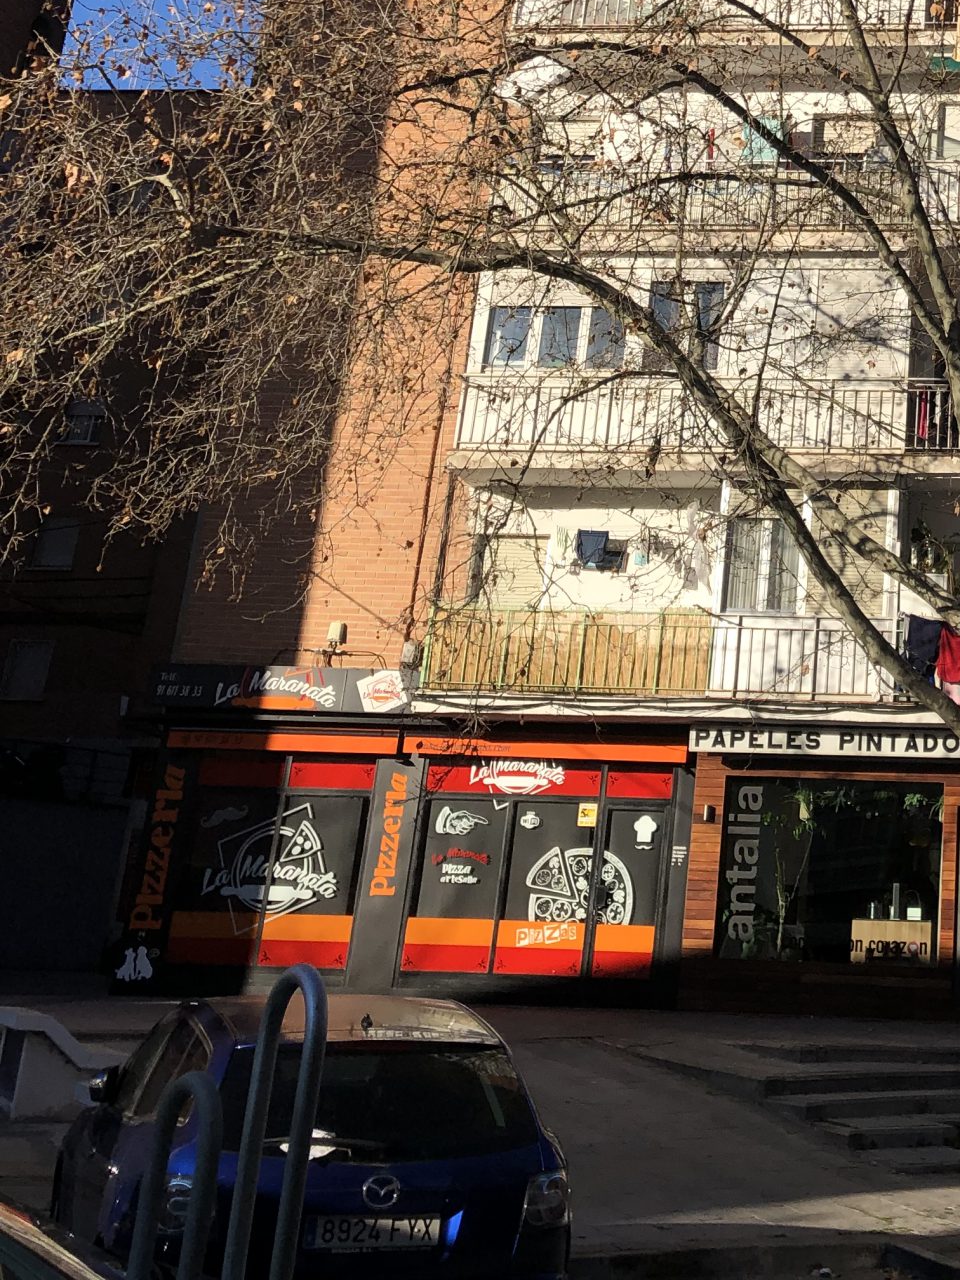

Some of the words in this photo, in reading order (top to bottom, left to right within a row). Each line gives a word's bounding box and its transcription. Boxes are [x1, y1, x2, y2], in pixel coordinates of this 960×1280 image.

[214, 681, 241, 706] La
[249, 671, 336, 709] Maranata
[694, 728, 821, 751] PAPELES
[469, 761, 490, 785] La
[496, 759, 566, 785] Maranata
[200, 867, 230, 896] La
[240, 854, 337, 899] Maranata
[725, 785, 764, 942] antalia
[322, 1219, 381, 1243] 8924
[390, 1218, 434, 1242] FYX
